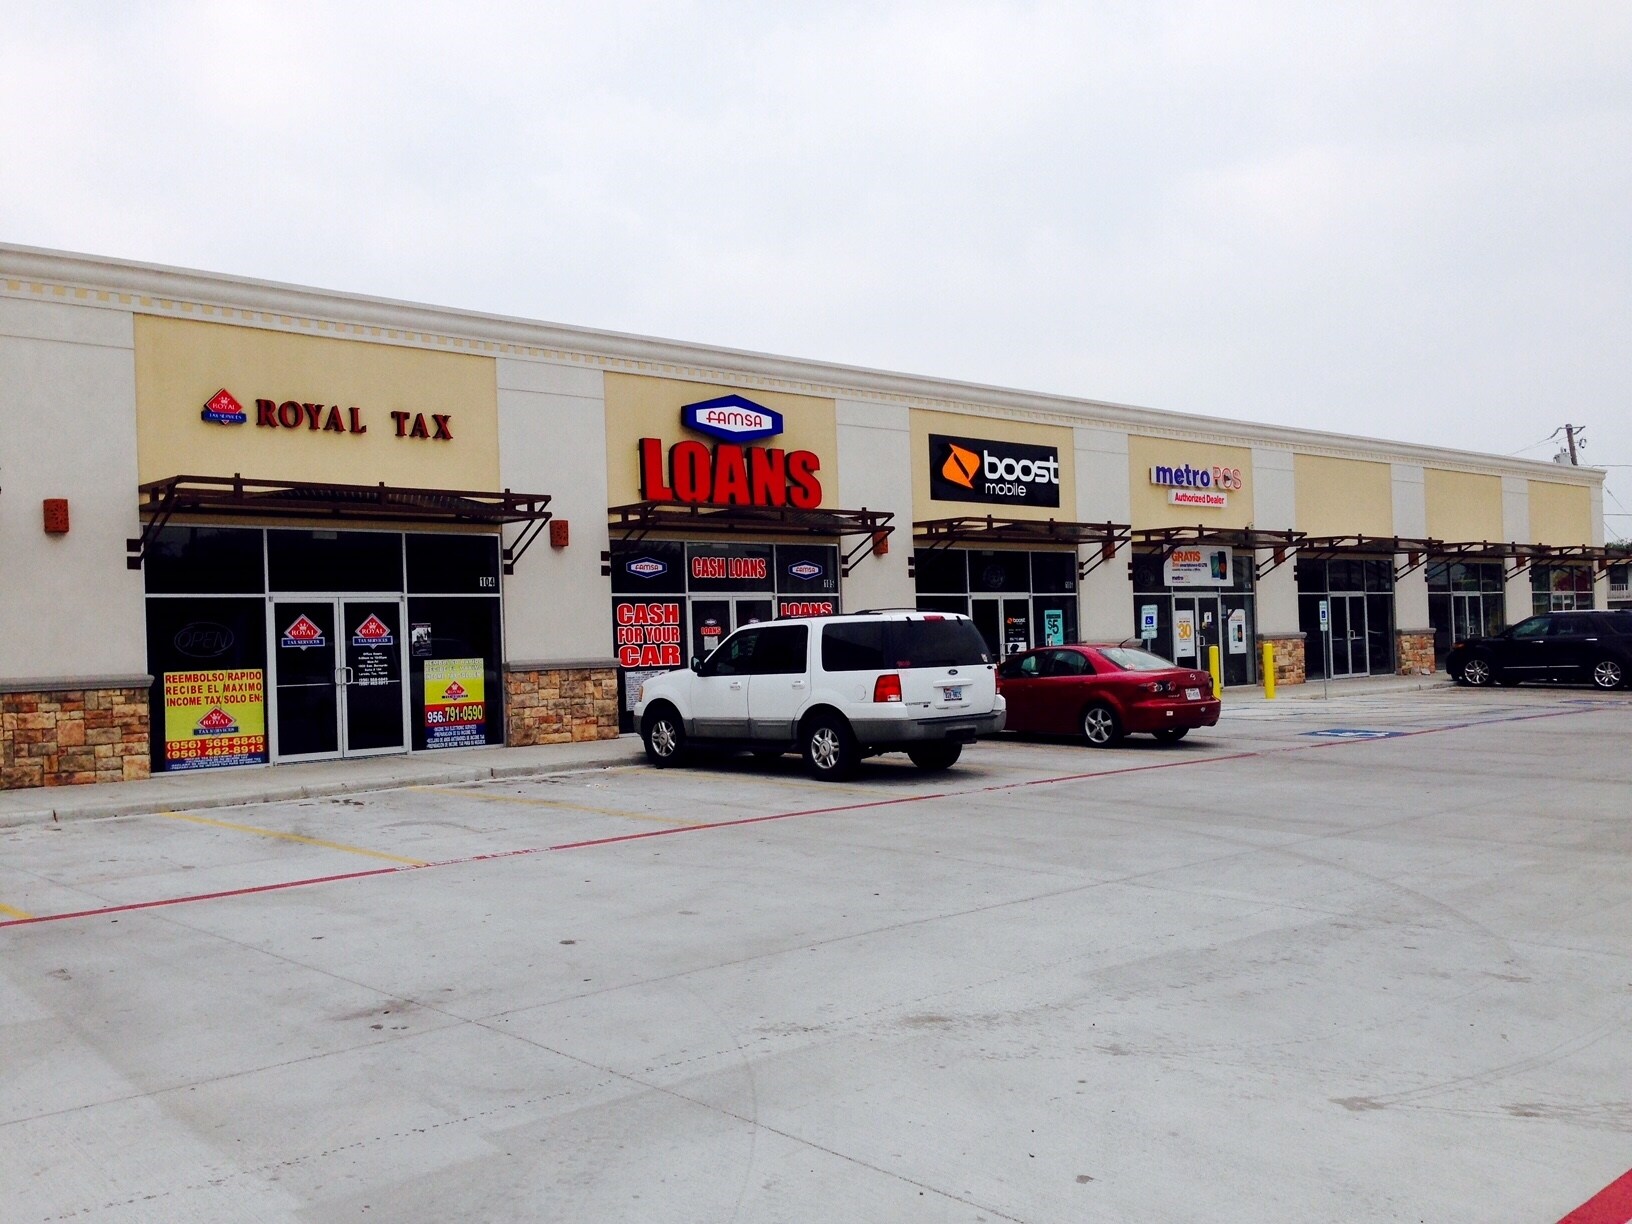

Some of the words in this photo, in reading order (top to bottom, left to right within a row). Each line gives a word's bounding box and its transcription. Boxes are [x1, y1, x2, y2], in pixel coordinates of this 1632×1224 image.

[256, 399, 367, 433] ROYAL
[391, 411, 454, 440] TAX
[706, 410, 762, 428] FAMSA
[640, 438, 822, 510] LOANS
[983, 449, 1060, 485] boost
[985, 481, 1027, 497] mobile
[1174, 492, 1206, 504] Authorized
[1206, 494, 1225, 505] Dealer
[1172, 551, 1201, 562] GRATIS
[692, 556, 727, 579] CASH
[728, 557, 767, 579] LOANS
[480, 577, 495, 587] 104
[617, 603, 680, 626] CASH
[780, 602, 833, 618] LOANS
[618, 626, 644, 645] FOR
[644, 625, 680, 644] YOUR
[1047, 619, 1060, 635] $5
[619, 644, 681, 668] CAR
[165, 672, 225, 684] REEMBOLSO
[227, 671, 262, 682] RAPIDO
[166, 685, 203, 696] RECIBE
[207, 684, 219, 694] EL
[222, 682, 263, 693] MAXIMO
[166, 696, 202, 707] INCOME
[205, 695, 222, 705] TAX
[223, 694, 247, 704] SOLO
[249, 693, 263, 702] EN:
[166, 740, 201, 750] (956)
[205, 735, 264, 748] 568-6849
[166, 749, 201, 760] (956)
[205, 744, 264, 756] 462-8913
